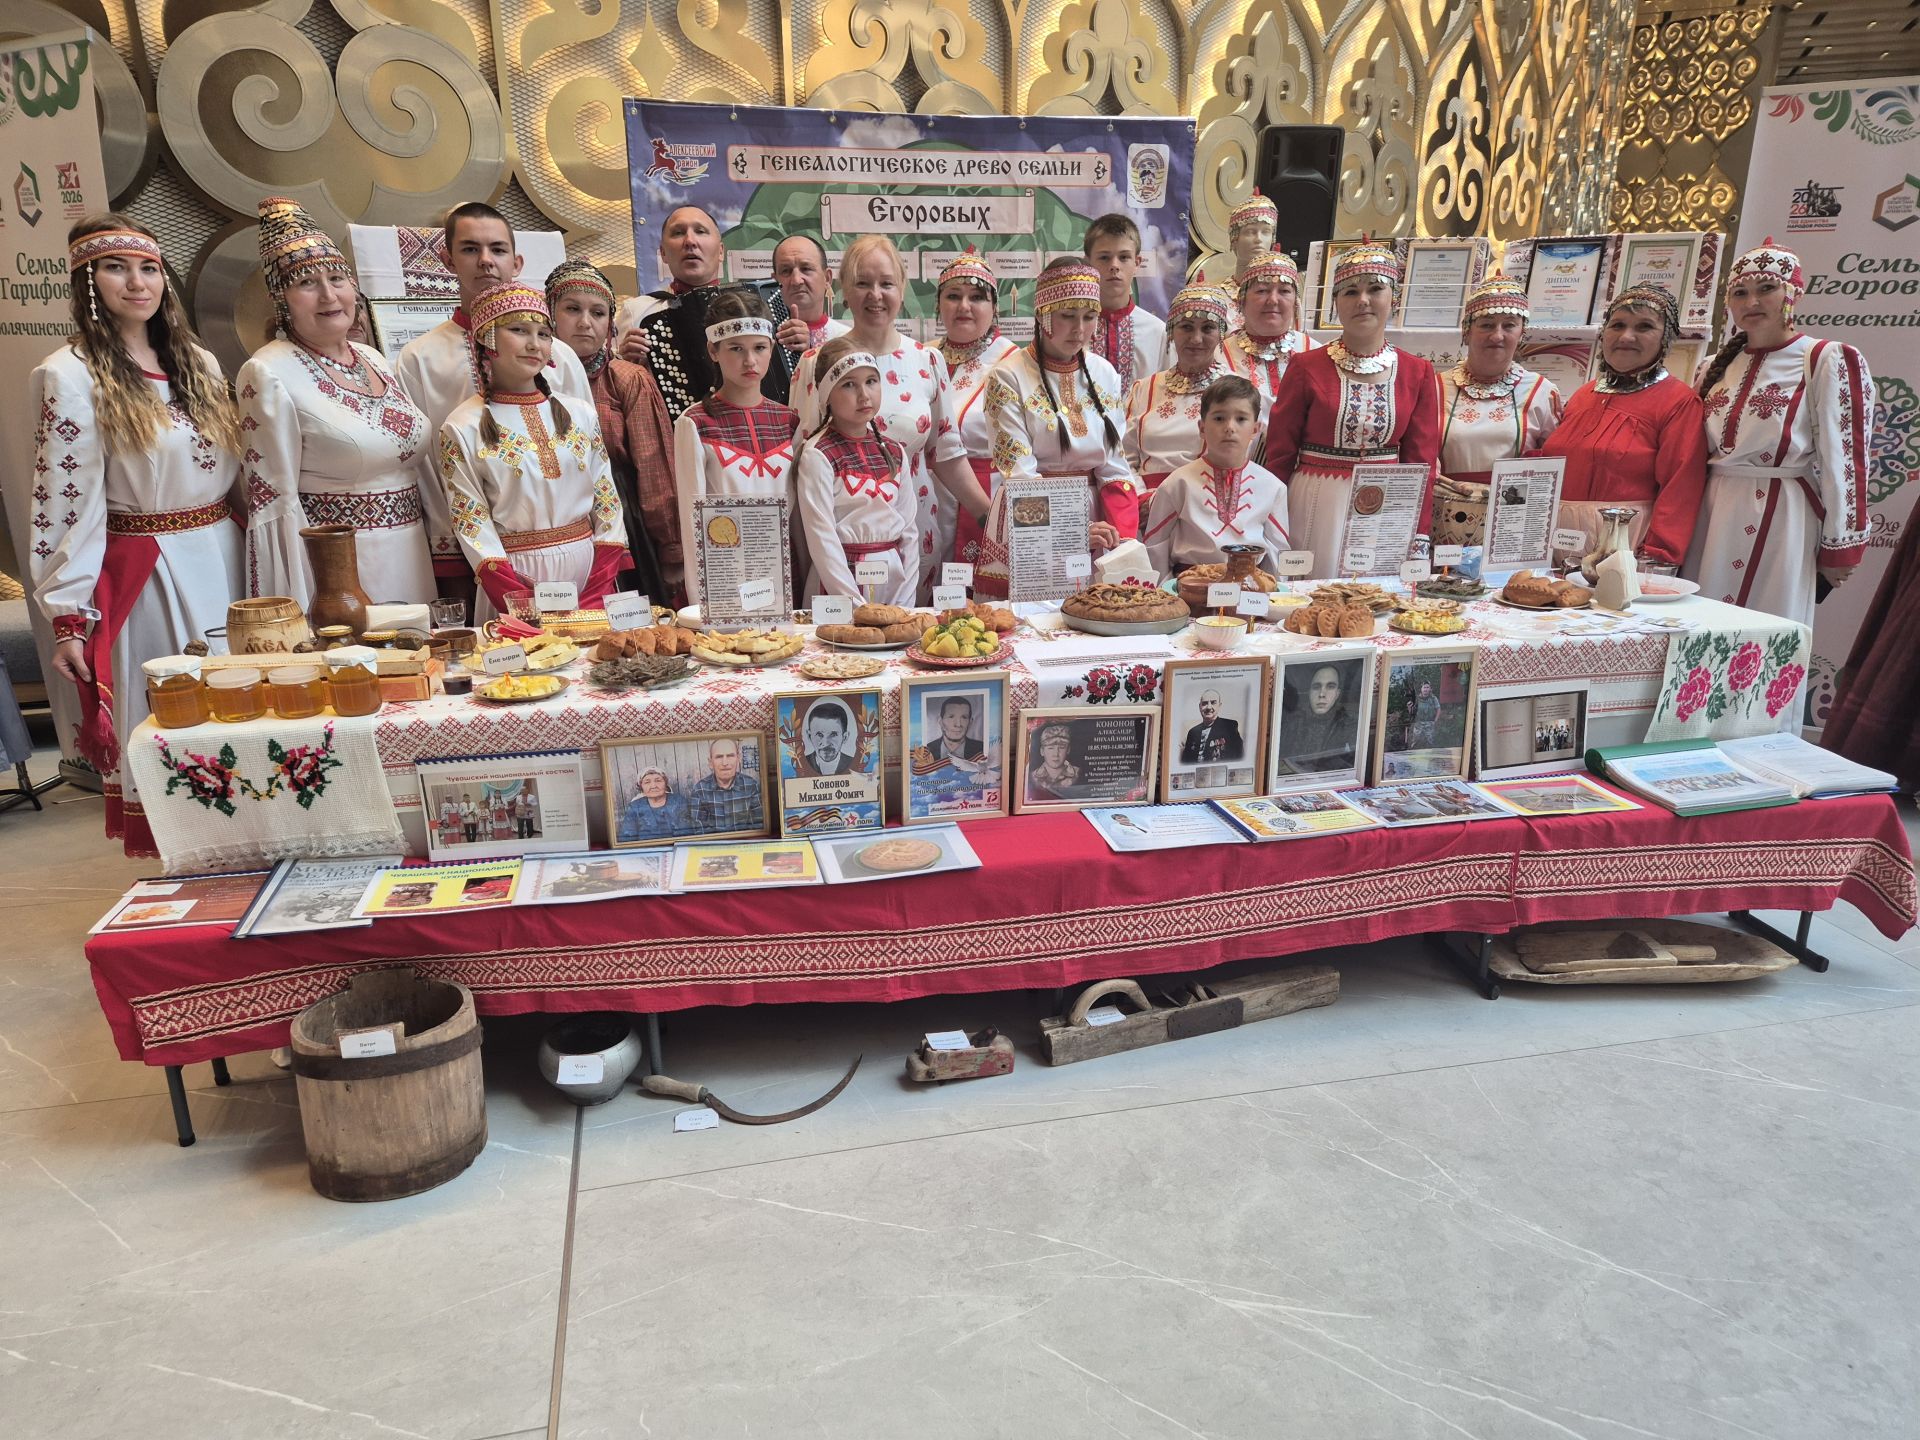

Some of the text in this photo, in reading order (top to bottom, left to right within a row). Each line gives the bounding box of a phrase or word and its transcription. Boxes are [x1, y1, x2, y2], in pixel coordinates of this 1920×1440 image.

[669, 143, 717, 157] АЛЕКСЕЕВСКИЙ
[676, 157, 698, 169] район
[760, 154, 947, 174] ГЕНЕАЛОГИЧЕСКОЕ
[60, 190, 83, 203] 2026
[1792, 192, 1809, 203] 20
[868, 197, 990, 231] Егоровых
[1790, 203, 1808, 215] 26
[16, 252, 68, 276] Семья
[1836, 253, 1920, 274] Семь
[0, 277, 72, 306] Гарифов
[1804, 275, 1920, 300] Егоров
[1792, 309, 1920, 327] ксеевский
[1870, 513, 1900, 534] Эхо
[1096, 720, 1135, 728] КОНОНОВ
[445, 773, 489, 783] Чувашский
[490, 769, 544, 780] национальный
[812, 779, 850, 790] Кононов
[798, 789, 865, 803] Михаил Фомич
[986, 791, 998, 803] 75
[390, 863, 520, 879] ЧУВАШСКАЯ НАЦИОНАЛЬНАЯ
[440, 873, 470, 881] КУХНЯ
